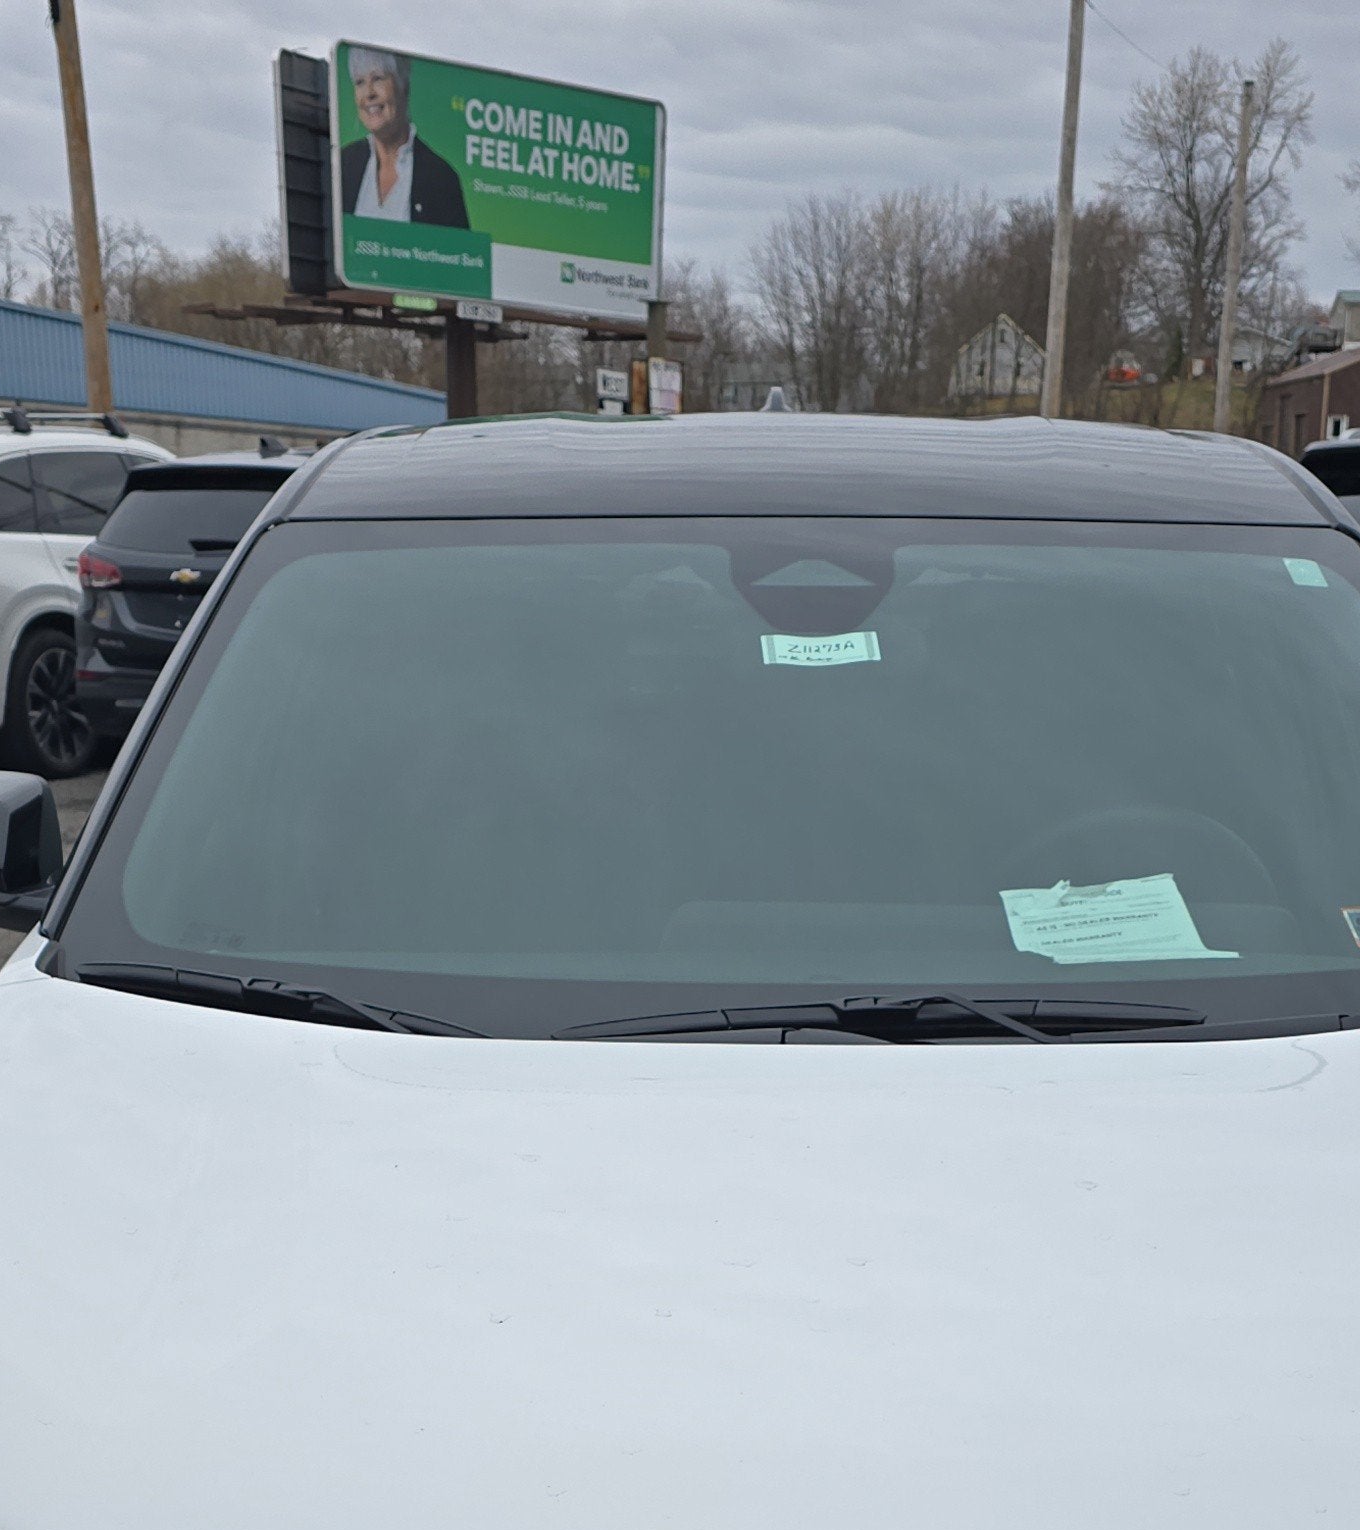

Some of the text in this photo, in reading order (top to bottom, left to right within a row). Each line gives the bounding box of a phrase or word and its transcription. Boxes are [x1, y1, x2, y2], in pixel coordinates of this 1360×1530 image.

[547, 113, 573, 148] IN
[576, 119, 630, 155] AND
[465, 134, 525, 174] FEEL
[527, 146, 560, 179] AT
[577, 267, 650, 289] Northwest Bank
